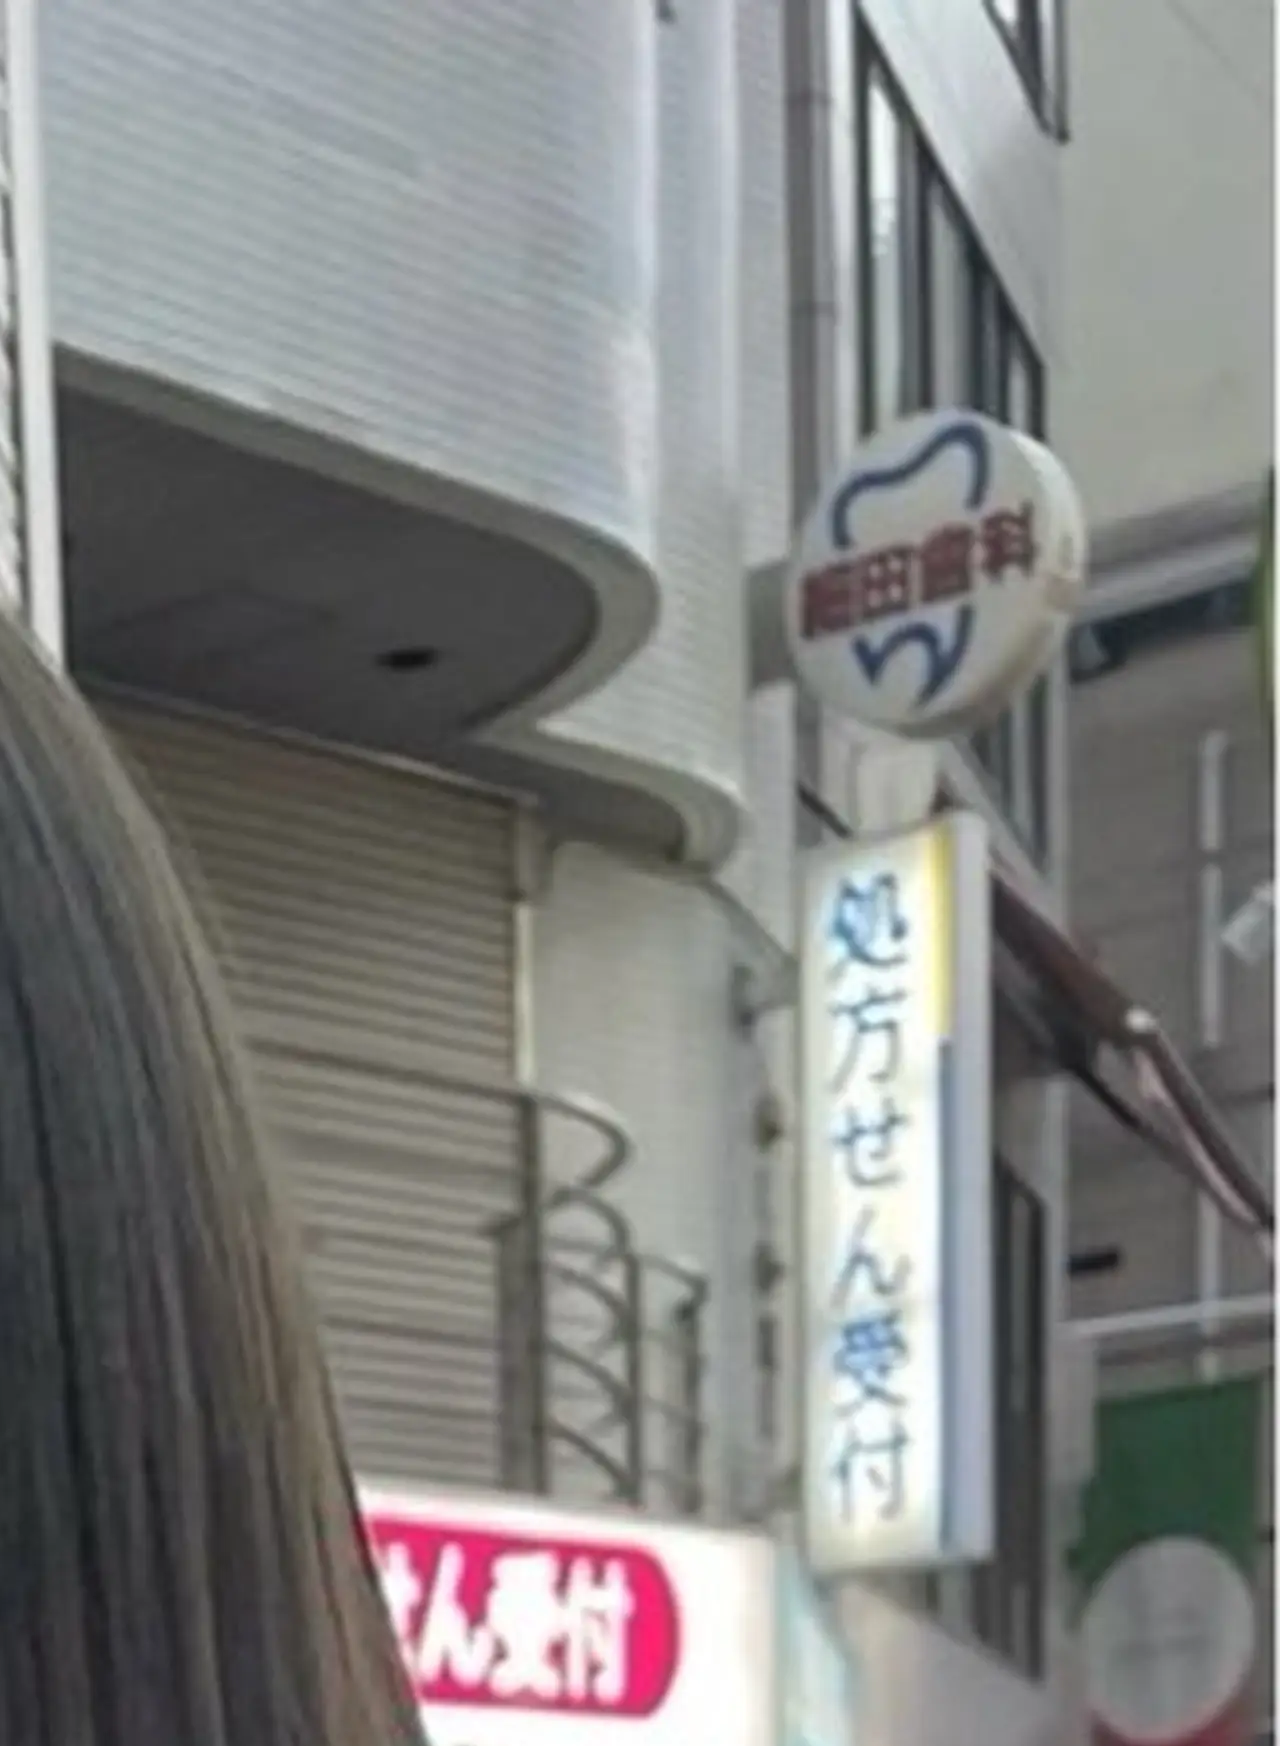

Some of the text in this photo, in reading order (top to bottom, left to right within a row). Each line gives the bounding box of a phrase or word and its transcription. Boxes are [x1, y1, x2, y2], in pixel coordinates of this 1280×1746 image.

[830, 872, 909, 1524] 処方せん受付
